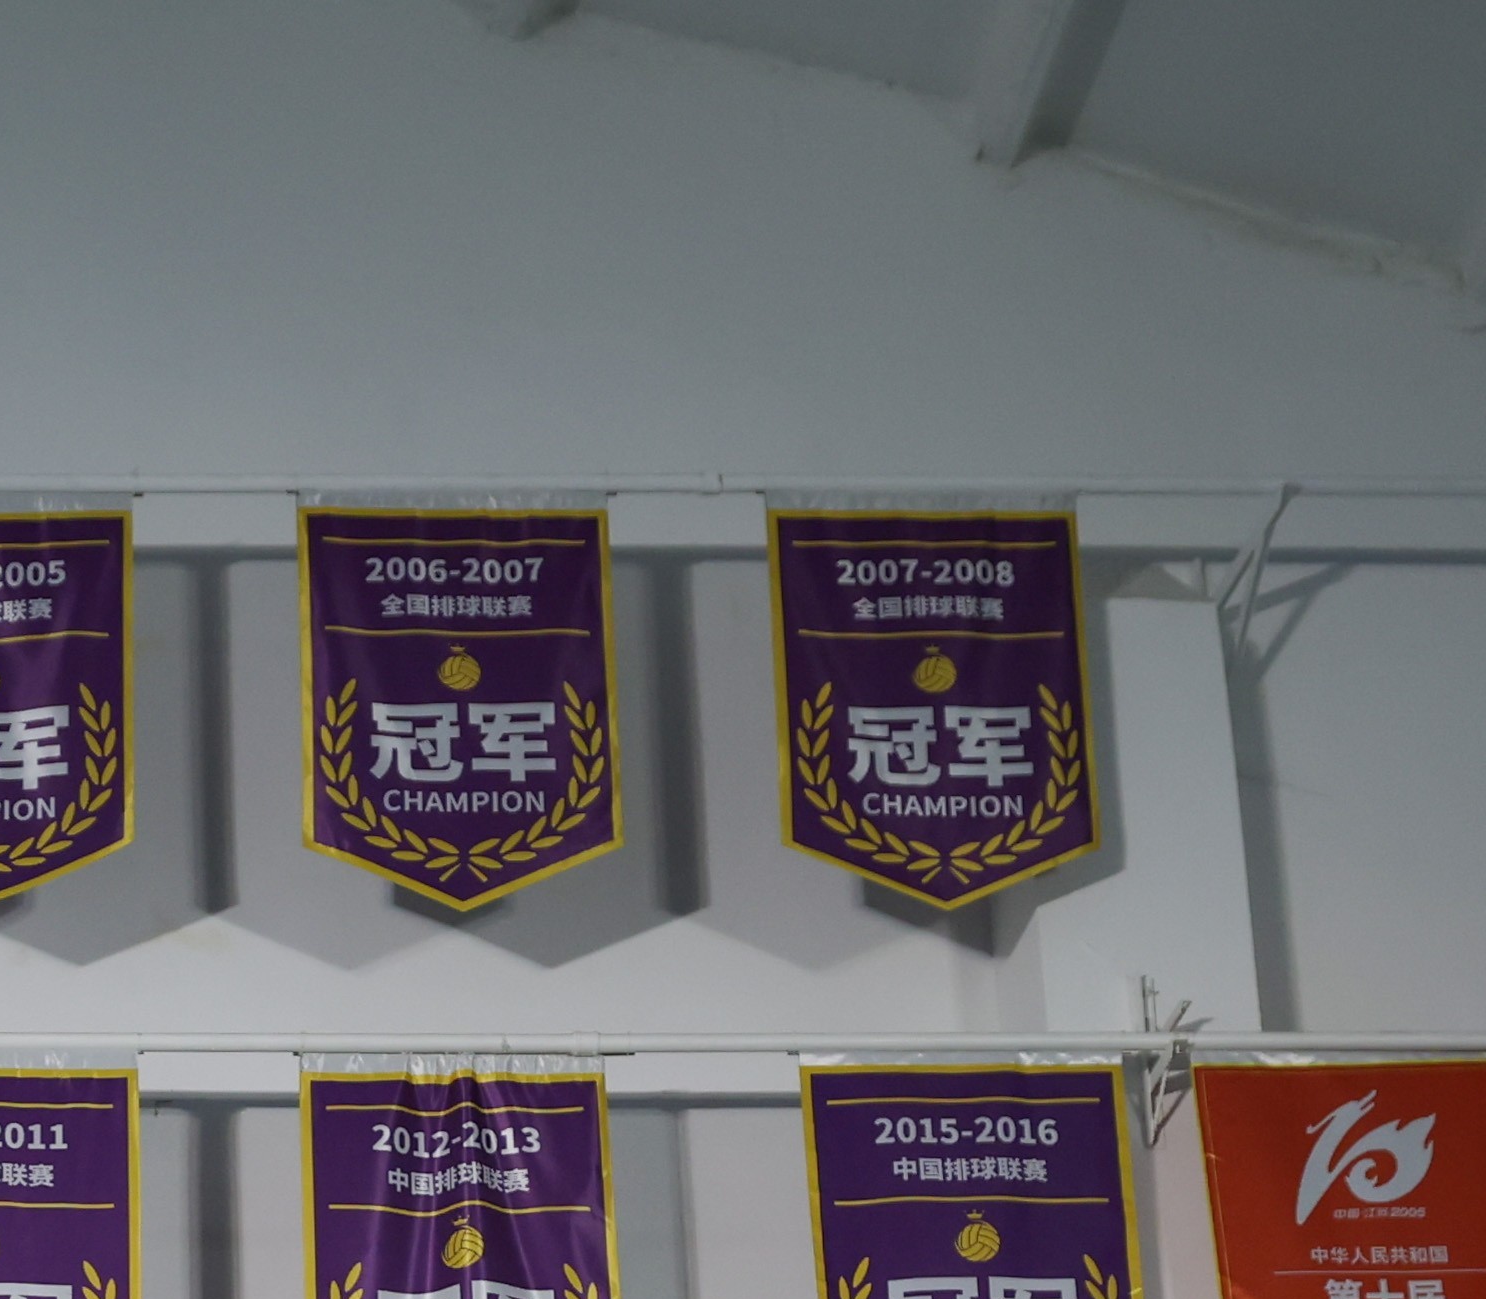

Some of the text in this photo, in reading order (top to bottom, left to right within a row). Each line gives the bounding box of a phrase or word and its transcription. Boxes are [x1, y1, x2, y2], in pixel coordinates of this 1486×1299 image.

[366, 557, 543, 584] 2006-2007
[837, 559, 1014, 586] 2007-2008
[381, 594, 531, 617] 全国排球联赛
[853, 595, 1003, 620] 全国排球联赛
[370, 703, 556, 781] 冠军
[848, 706, 1033, 787] 冠军
[383, 790, 544, 812] CHAMPION
[863, 793, 1023, 817] CHAMPION
[373, 1121, 540, 1158] 2012-2013
[875, 1117, 1058, 1145] 2015-2016
[388, 1161, 530, 1196] 中国排球联赛
[893, 1156, 1047, 1182] 中国排球联赛
[1311, 1246, 1449, 1264] 中华人民共和国
